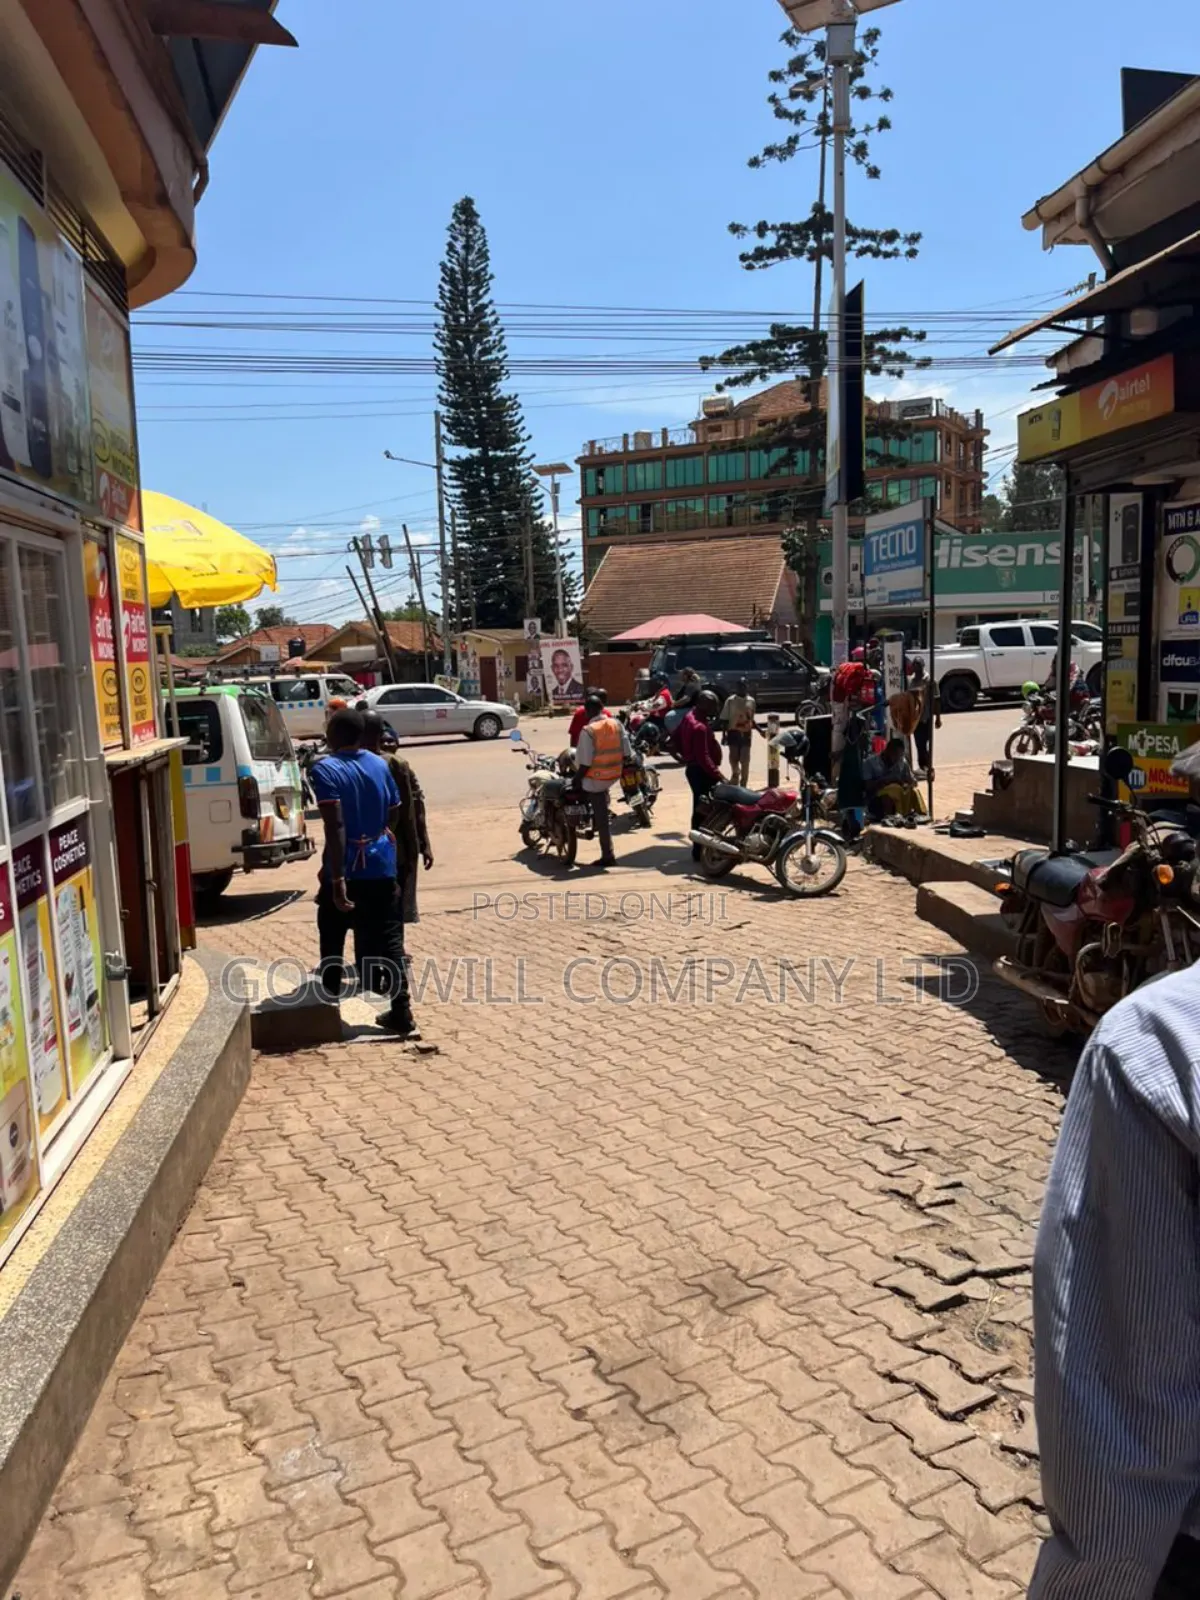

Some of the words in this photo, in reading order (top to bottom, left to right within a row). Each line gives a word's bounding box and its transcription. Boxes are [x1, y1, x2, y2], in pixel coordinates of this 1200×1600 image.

[1119, 372, 1151, 400] airtel
[870, 525, 916, 562] TECNO
[58, 829, 79, 851] PEACE
[13, 854, 32, 878] EACE
[53, 842, 86, 873] COSMETICS
